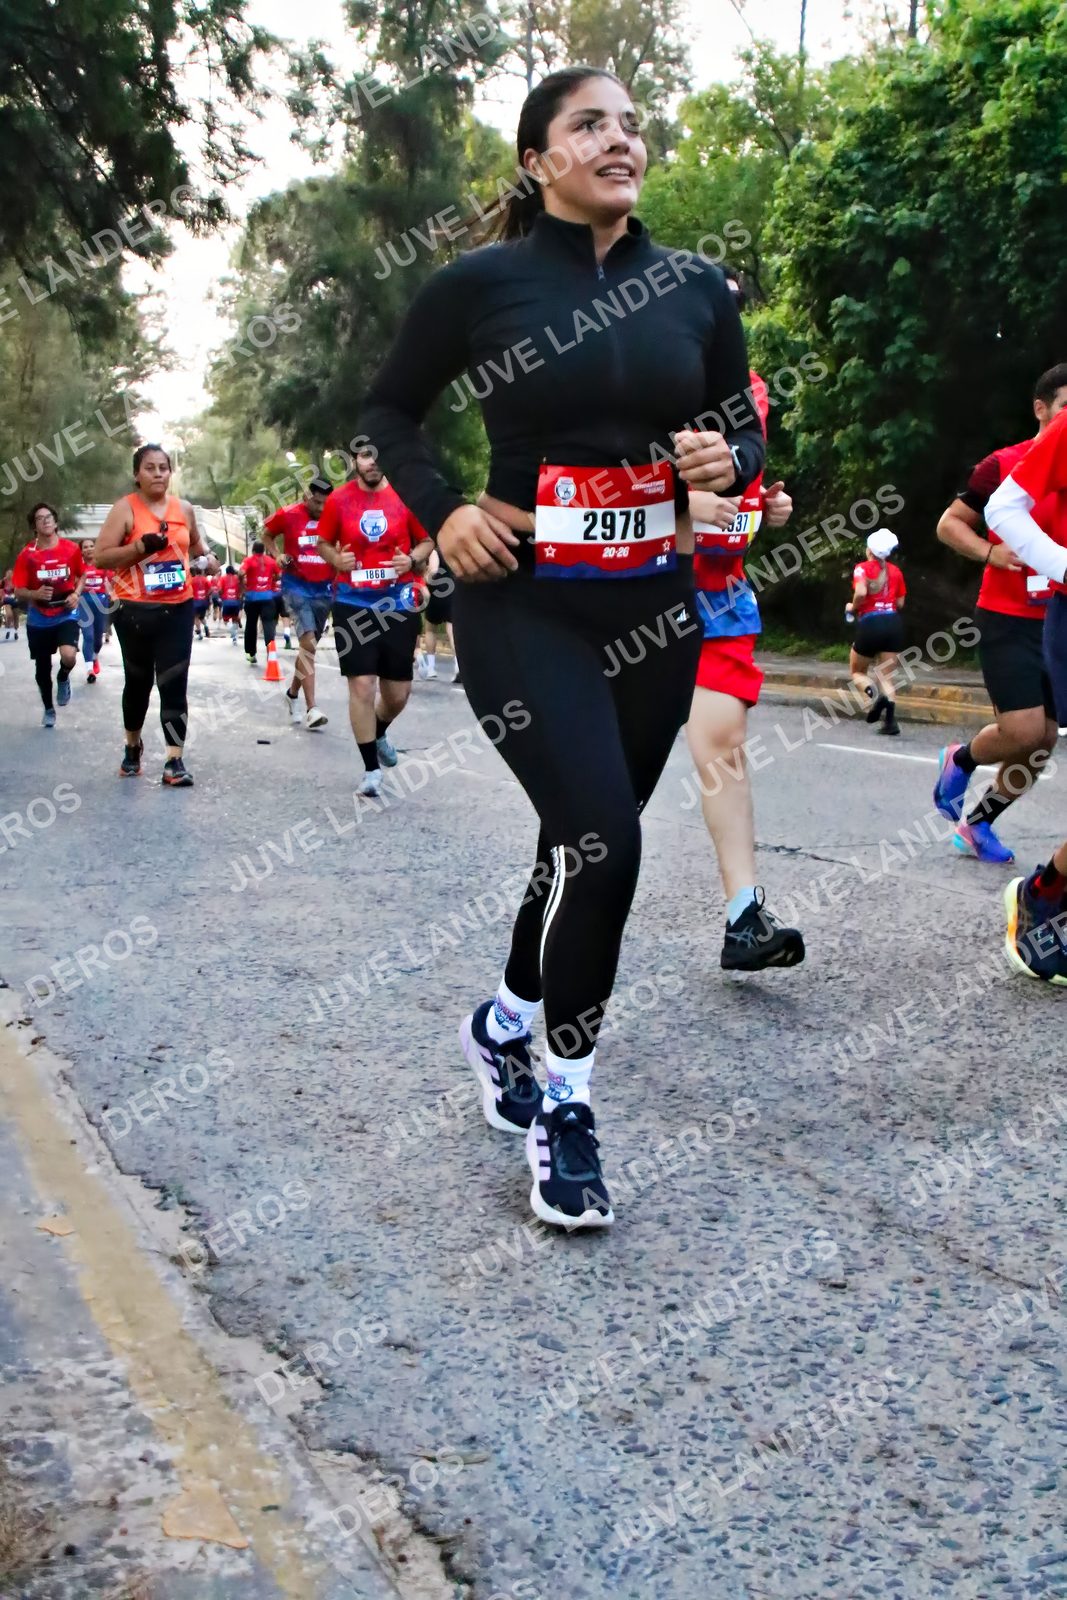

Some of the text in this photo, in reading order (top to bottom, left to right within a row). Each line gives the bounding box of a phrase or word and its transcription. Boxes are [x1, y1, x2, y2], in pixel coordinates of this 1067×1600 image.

[583, 508, 647, 541] 2978
[656, 554, 668, 566] 5K
[365, 569, 386, 579] 1868
